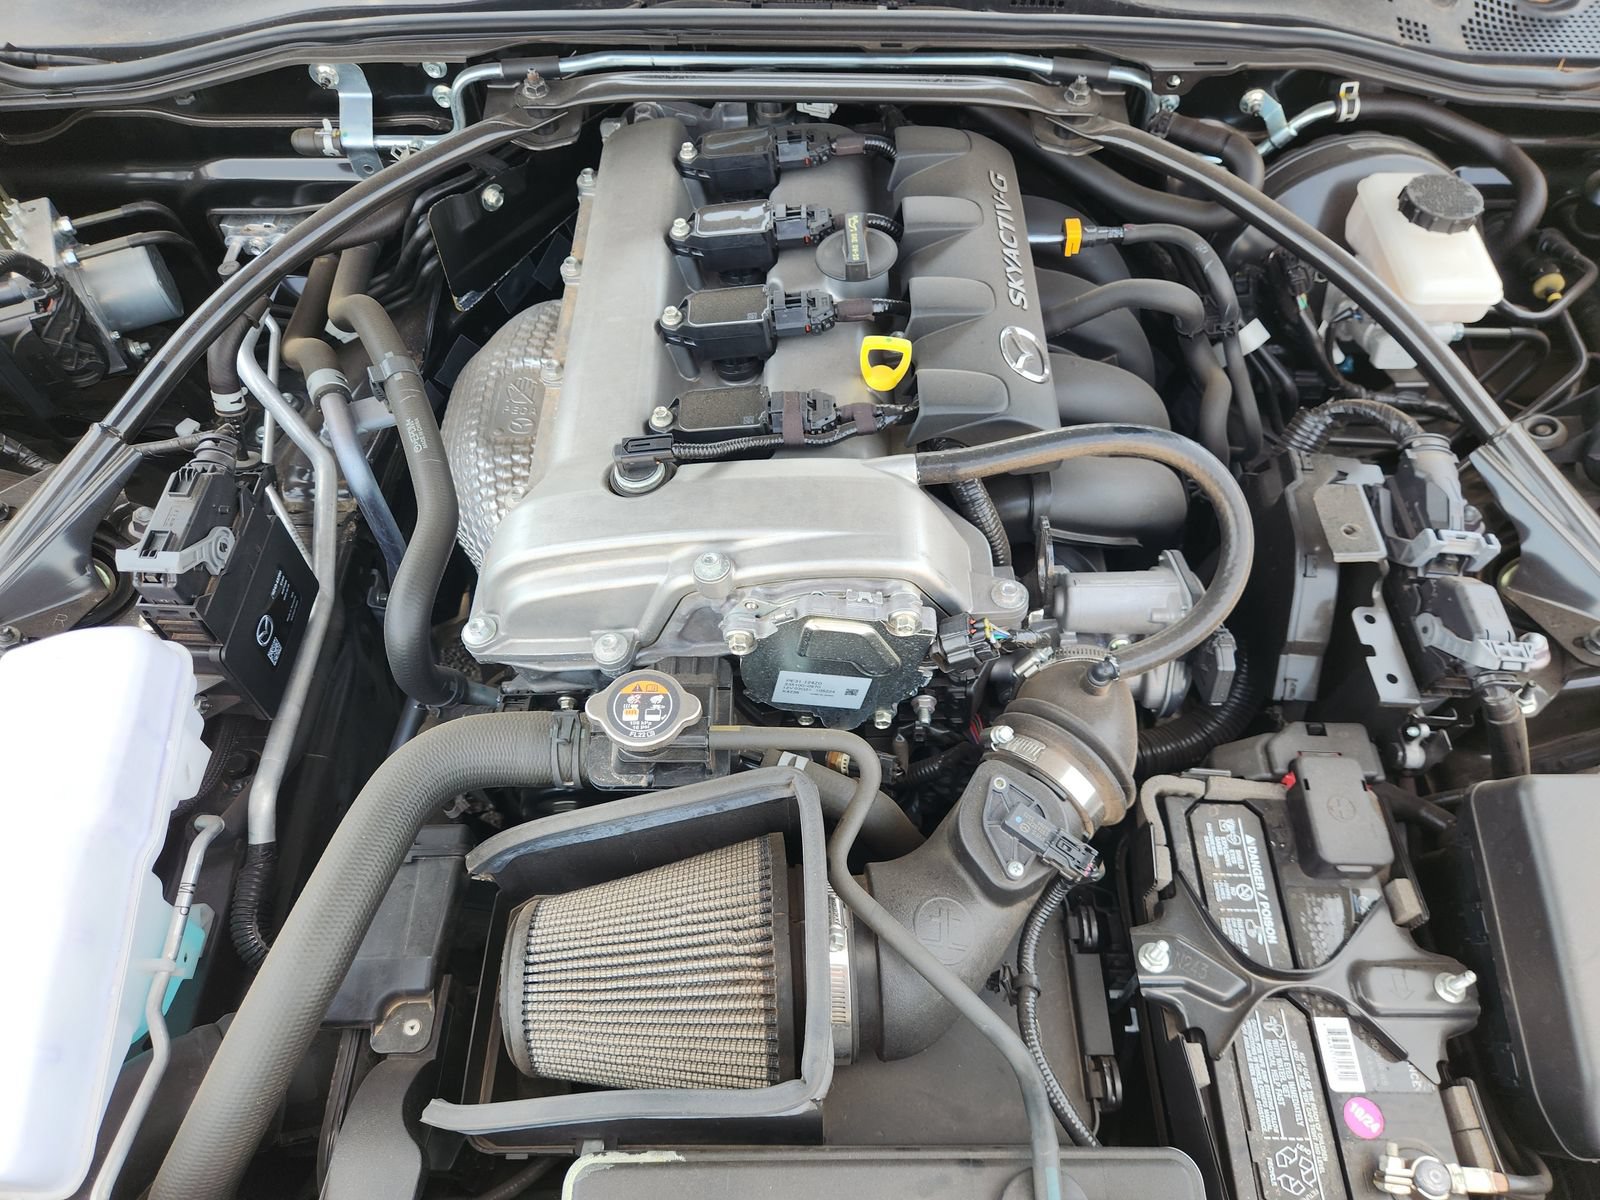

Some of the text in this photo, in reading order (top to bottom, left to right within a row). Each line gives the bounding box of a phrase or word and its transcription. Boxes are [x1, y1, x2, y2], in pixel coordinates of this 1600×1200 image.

[988, 170, 1027, 309] SKYACTIV-G
[1247, 846, 1266, 891] DANGER
[1259, 901, 1278, 944] POISON
[1263, 1038, 1285, 1106] MEDICAL HELP FAST
[1278, 1039, 1304, 1127] FLUSH EYES IMMEDIATELY
[1281, 1083, 1290, 1098] GET
[1302, 1067, 1310, 1080] OUT
[1314, 1122, 1322, 1131] OF
[1268, 1110, 1279, 1133] FOLLOW
[1290, 1040, 1297, 1049] DO
[1316, 1156, 1325, 1174] LEVEL
[1348, 1101, 1381, 1133] 10/24
[1265, 1156, 1277, 1186] RECYCLE
[1295, 1142, 1311, 1155] LEAD
